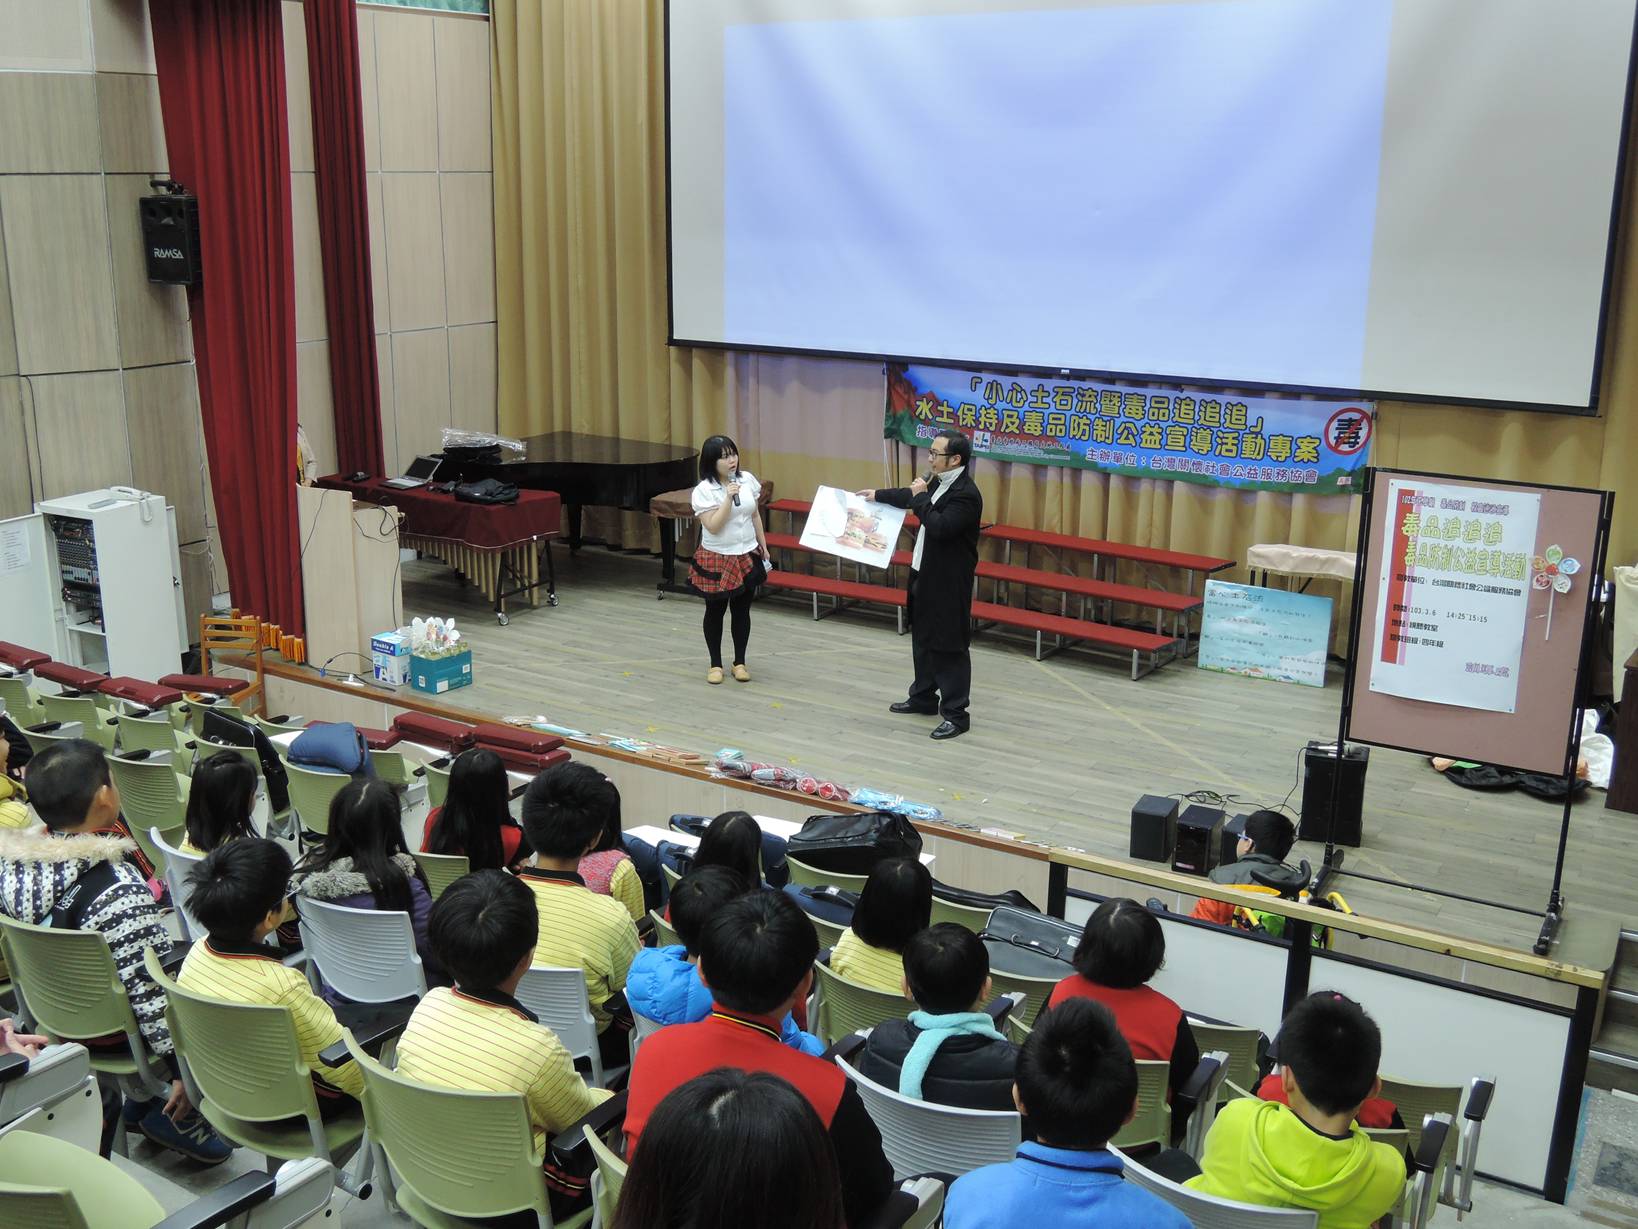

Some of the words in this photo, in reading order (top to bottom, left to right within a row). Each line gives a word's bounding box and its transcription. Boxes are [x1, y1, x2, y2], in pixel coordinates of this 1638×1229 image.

[153, 247, 185, 259] RAMSA
[970, 376, 1264, 432] 「小心土石流暨毒品追追追」
[915, 397, 1322, 464] 水土保持及毒品防制公益宣導活動專案
[1401, 512, 1503, 546] 毒品追追追
[372, 640, 390, 651] Double
